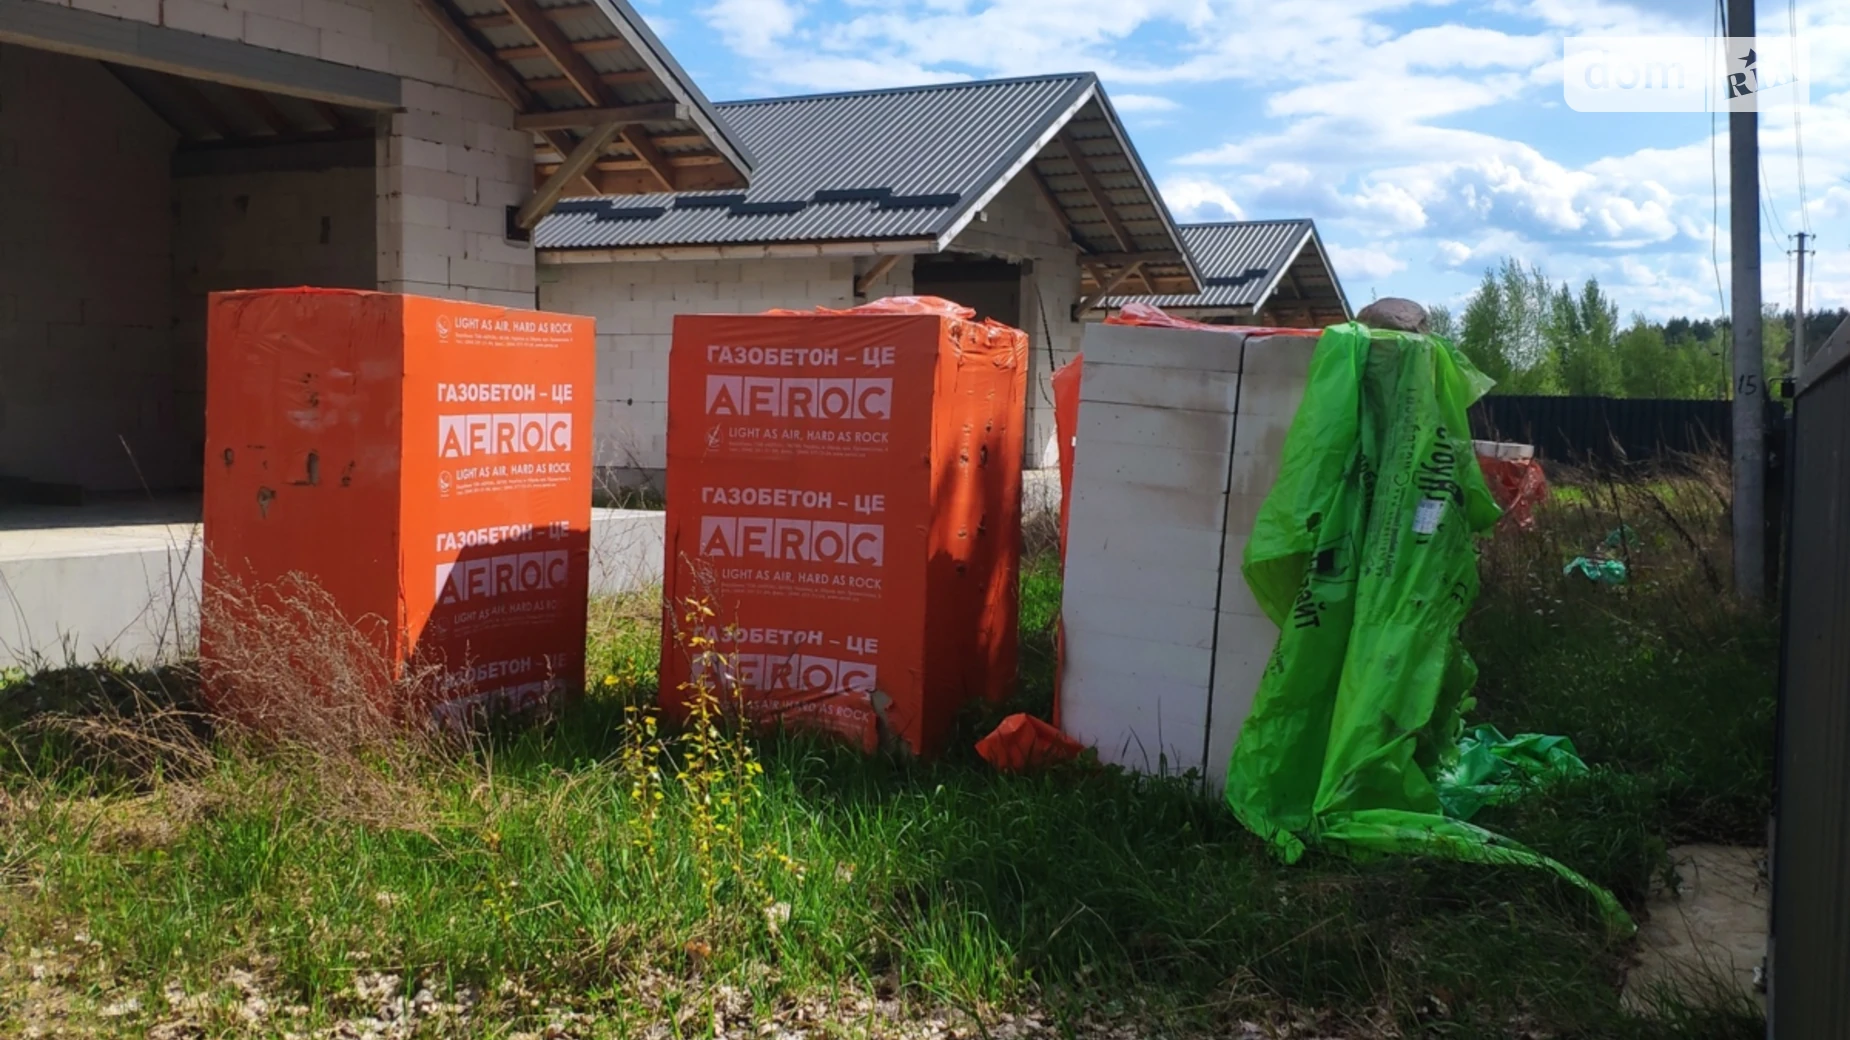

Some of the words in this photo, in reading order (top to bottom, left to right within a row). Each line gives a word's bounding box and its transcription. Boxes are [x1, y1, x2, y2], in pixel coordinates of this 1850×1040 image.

[454, 317, 479, 329] LIGHT
[480, 319, 492, 331] AS
[512, 320, 535, 333] HARD
[537, 322, 549, 333] AS
[550, 322, 573, 334] ROCK
[707, 345, 838, 366] ГАЗОБЕТОН
[863, 347, 895, 368] ЦЕ
[437, 383, 535, 402] ГАЗОБЕТОН
[552, 384, 573, 404] ЦЕ
[1738, 373, 1757, 396] 15
[705, 374, 893, 420] AEROC
[438, 413, 572, 458] AEROC
[728, 427, 761, 438] LIGHT
[763, 429, 778, 439] AS
[807, 430, 835, 442] HARD
[837, 431, 852, 442] AS
[855, 432, 889, 444] ROCK
[455, 467, 478, 481] LIGHT
[479, 465, 490, 477] AS
[511, 463, 534, 475] HARD
[536, 463, 548, 475] AS
[549, 462, 571, 473] ROCK
[701, 487, 832, 508] ГАЗОБЕТОН
[854, 494, 885, 515] ЦЕ
[436, 523, 533, 552] ГАЗОБЕТОН
[549, 521, 569, 540] ЦЕ
[701, 516, 884, 567] AEROC
[435, 550, 568, 604] AEROC
[722, 568, 753, 580] LIGHT
[755, 570, 770, 581] AS
[798, 572, 829, 584] HARD
[832, 574, 846, 586] AS
[849, 576, 882, 590] ROCK
[454, 611, 477, 624] LIGHT
[478, 609, 490, 621] AS
[534, 601, 546, 611] AS
[846, 635, 879, 655] ЦЕ
